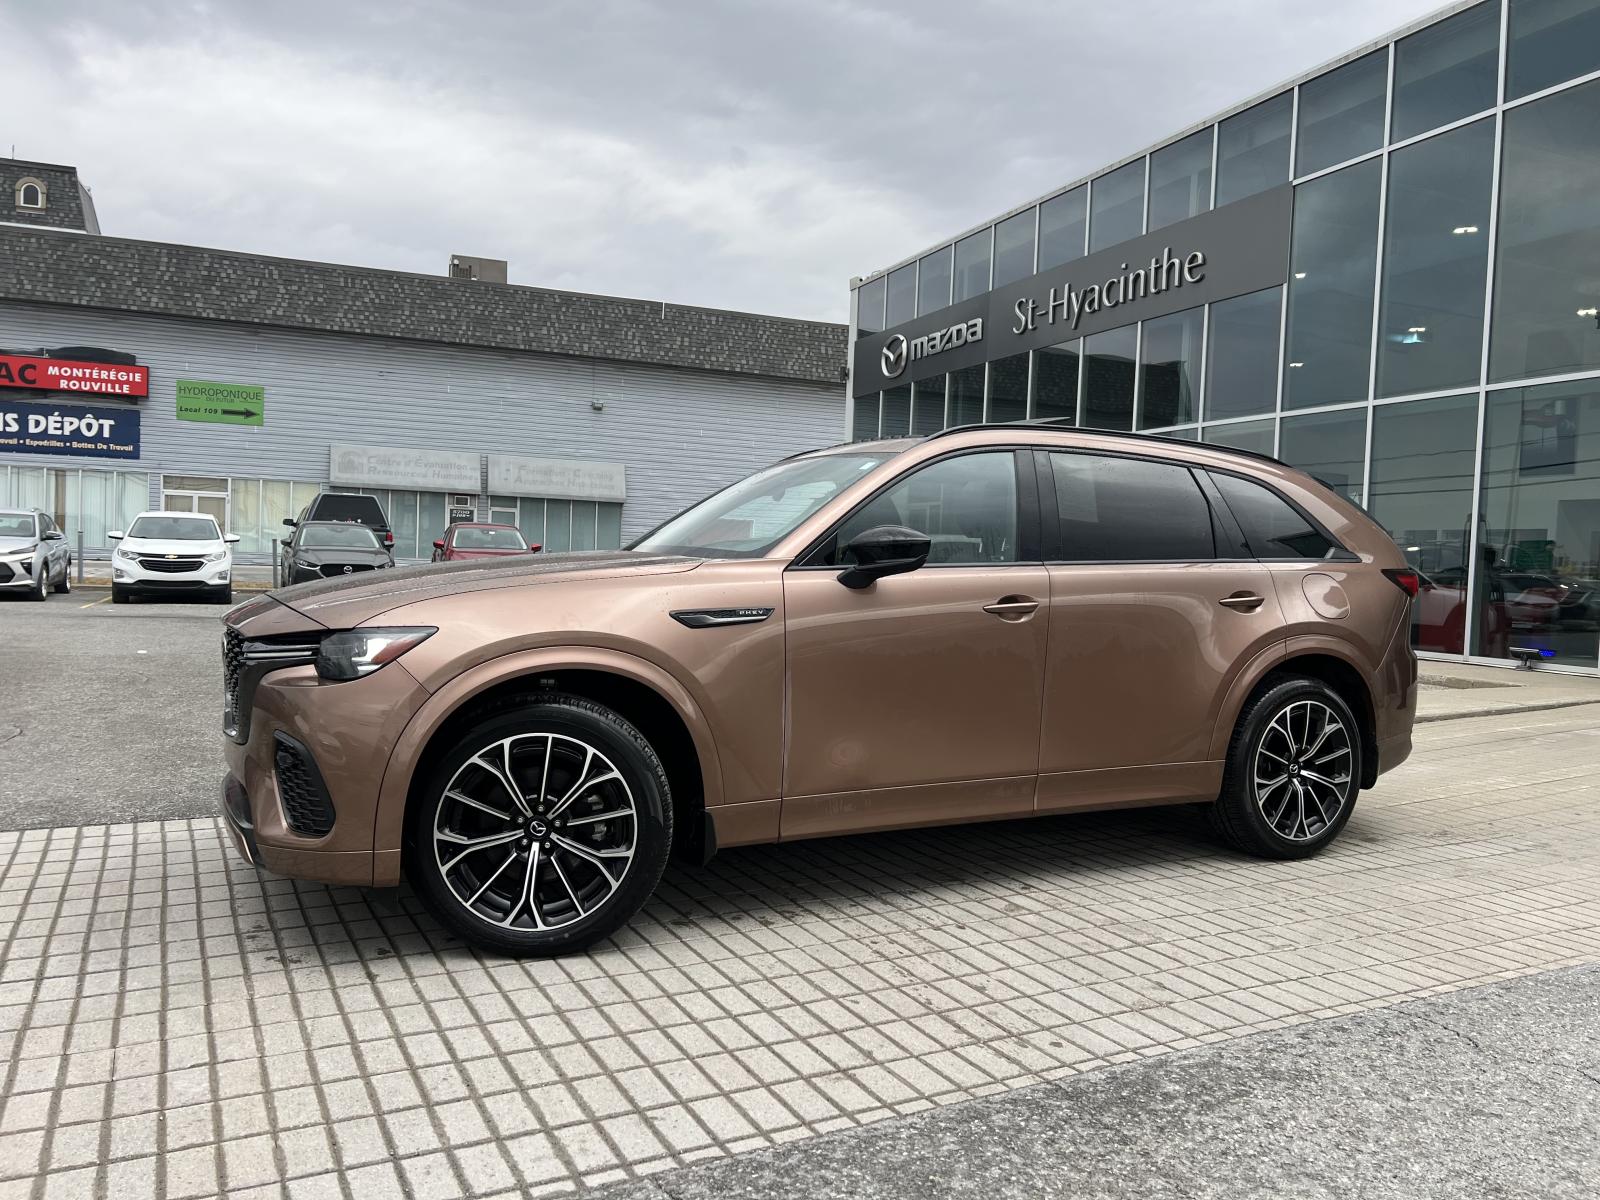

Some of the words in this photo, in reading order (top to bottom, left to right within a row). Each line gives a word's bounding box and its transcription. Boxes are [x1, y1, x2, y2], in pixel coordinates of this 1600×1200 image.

[1012, 246, 1206, 334] St-Hyacinthe
[910, 317, 984, 361] mazda
[0, 361, 37, 385] AC
[47, 365, 142, 382] MONTÉRÉGIE
[59, 379, 130, 393] ROUVILLE
[178, 386, 262, 400] HYDROPONIQUE
[204, 407, 218, 415] 109
[0, 412, 19, 433] S
[28, 411, 115, 438] DÉPÔT
[25, 438, 64, 447] Espadrilles
[71, 441, 95, 449] Bottes
[97, 442, 108, 450] De
[109, 443, 133, 451] Travail
